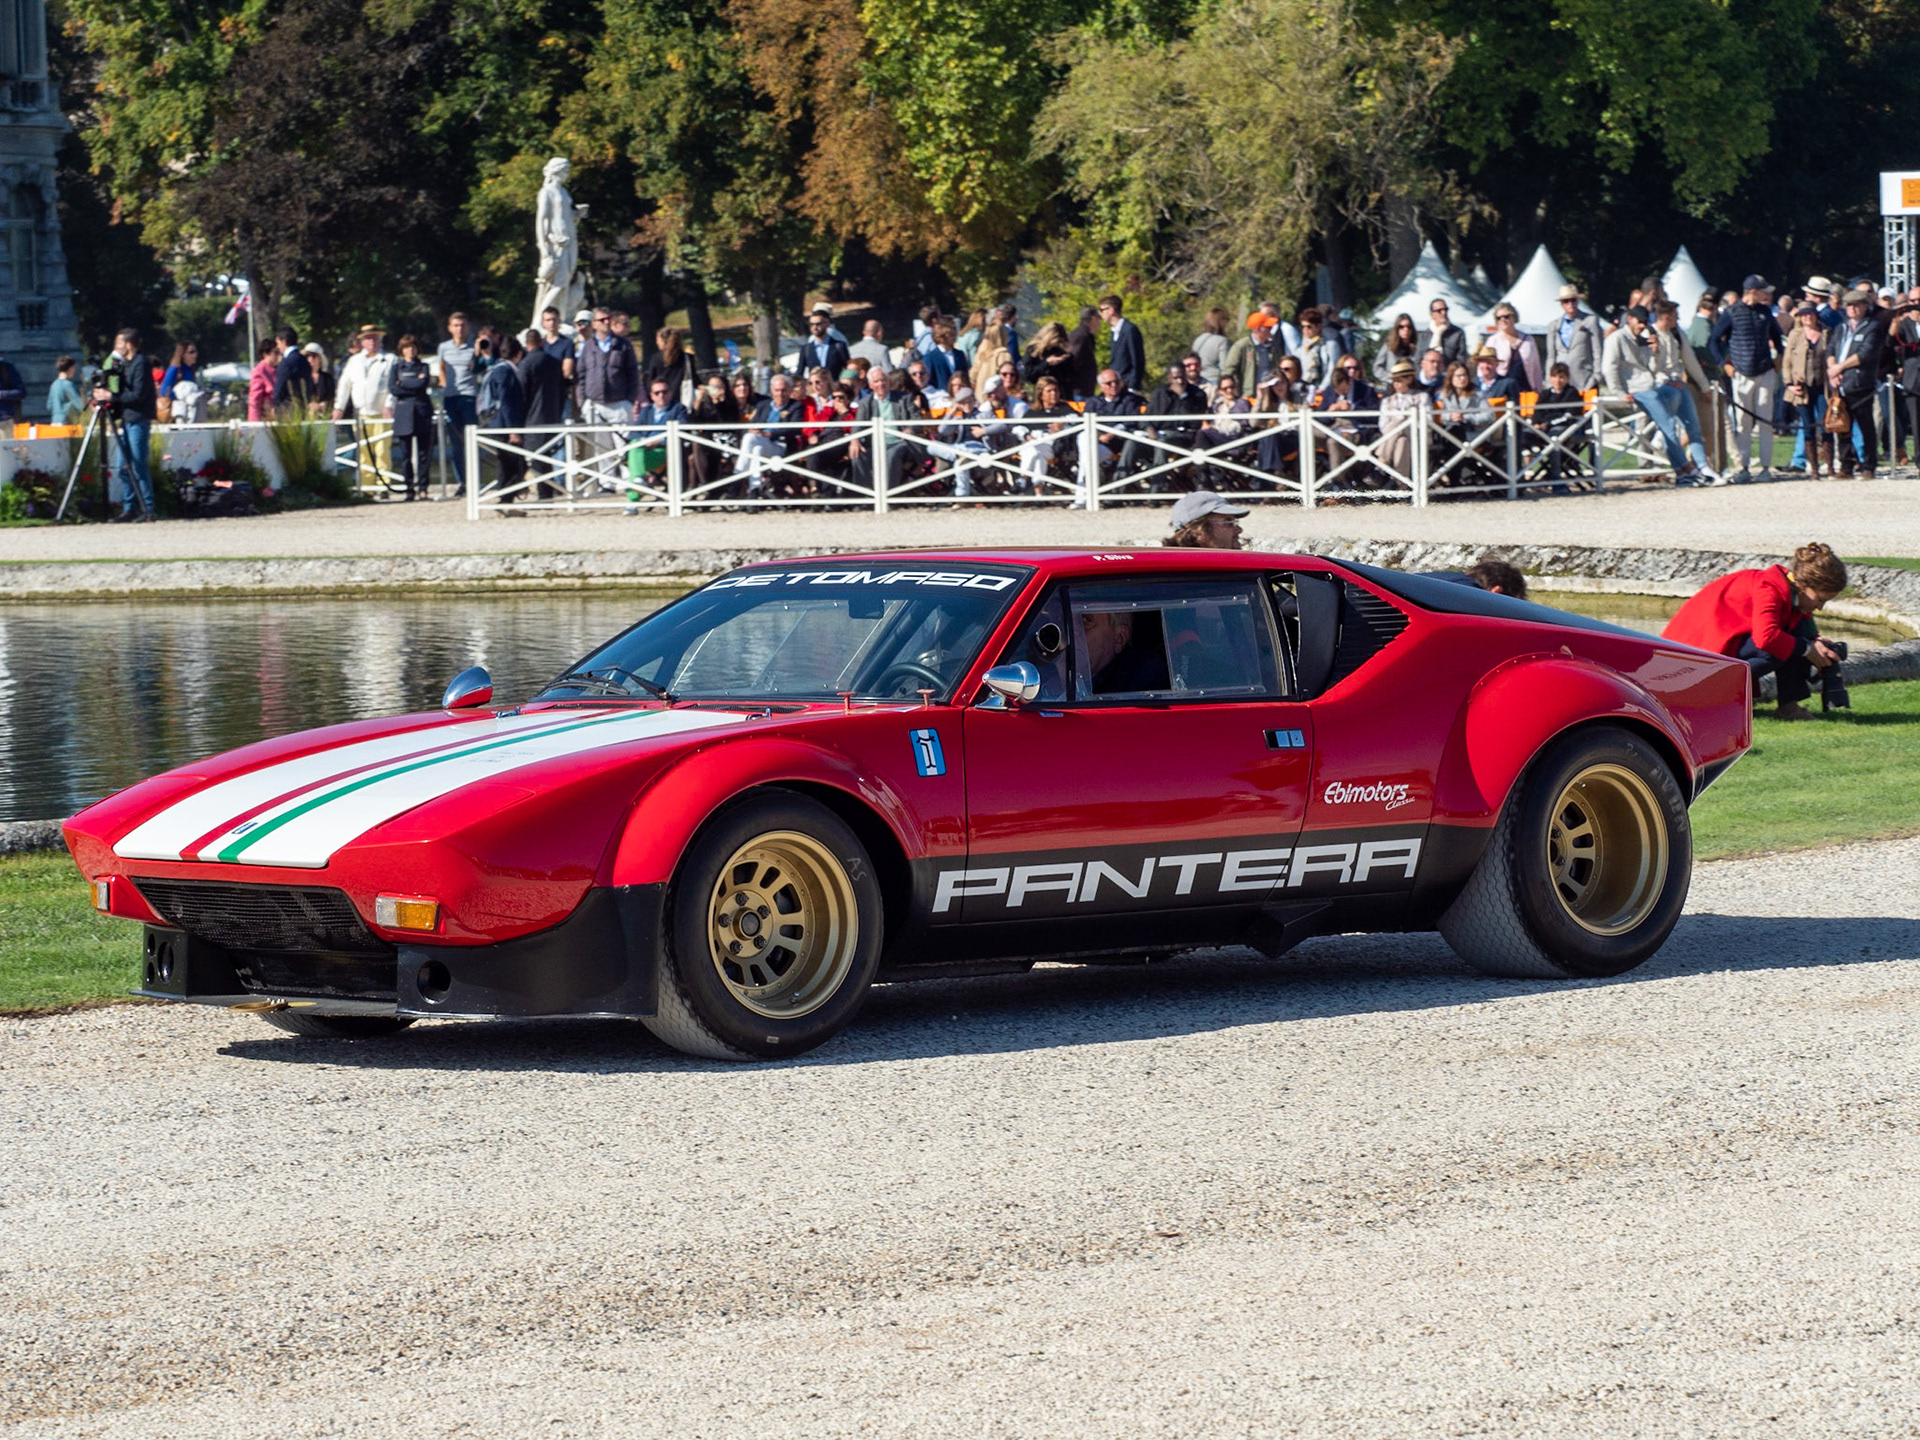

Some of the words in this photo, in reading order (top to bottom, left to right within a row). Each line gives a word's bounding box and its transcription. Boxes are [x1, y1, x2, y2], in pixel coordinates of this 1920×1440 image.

[1324, 781, 1409, 804] Ebimotors
[1385, 797, 1416, 811] Classic
[931, 838, 1422, 912] PANTERA
